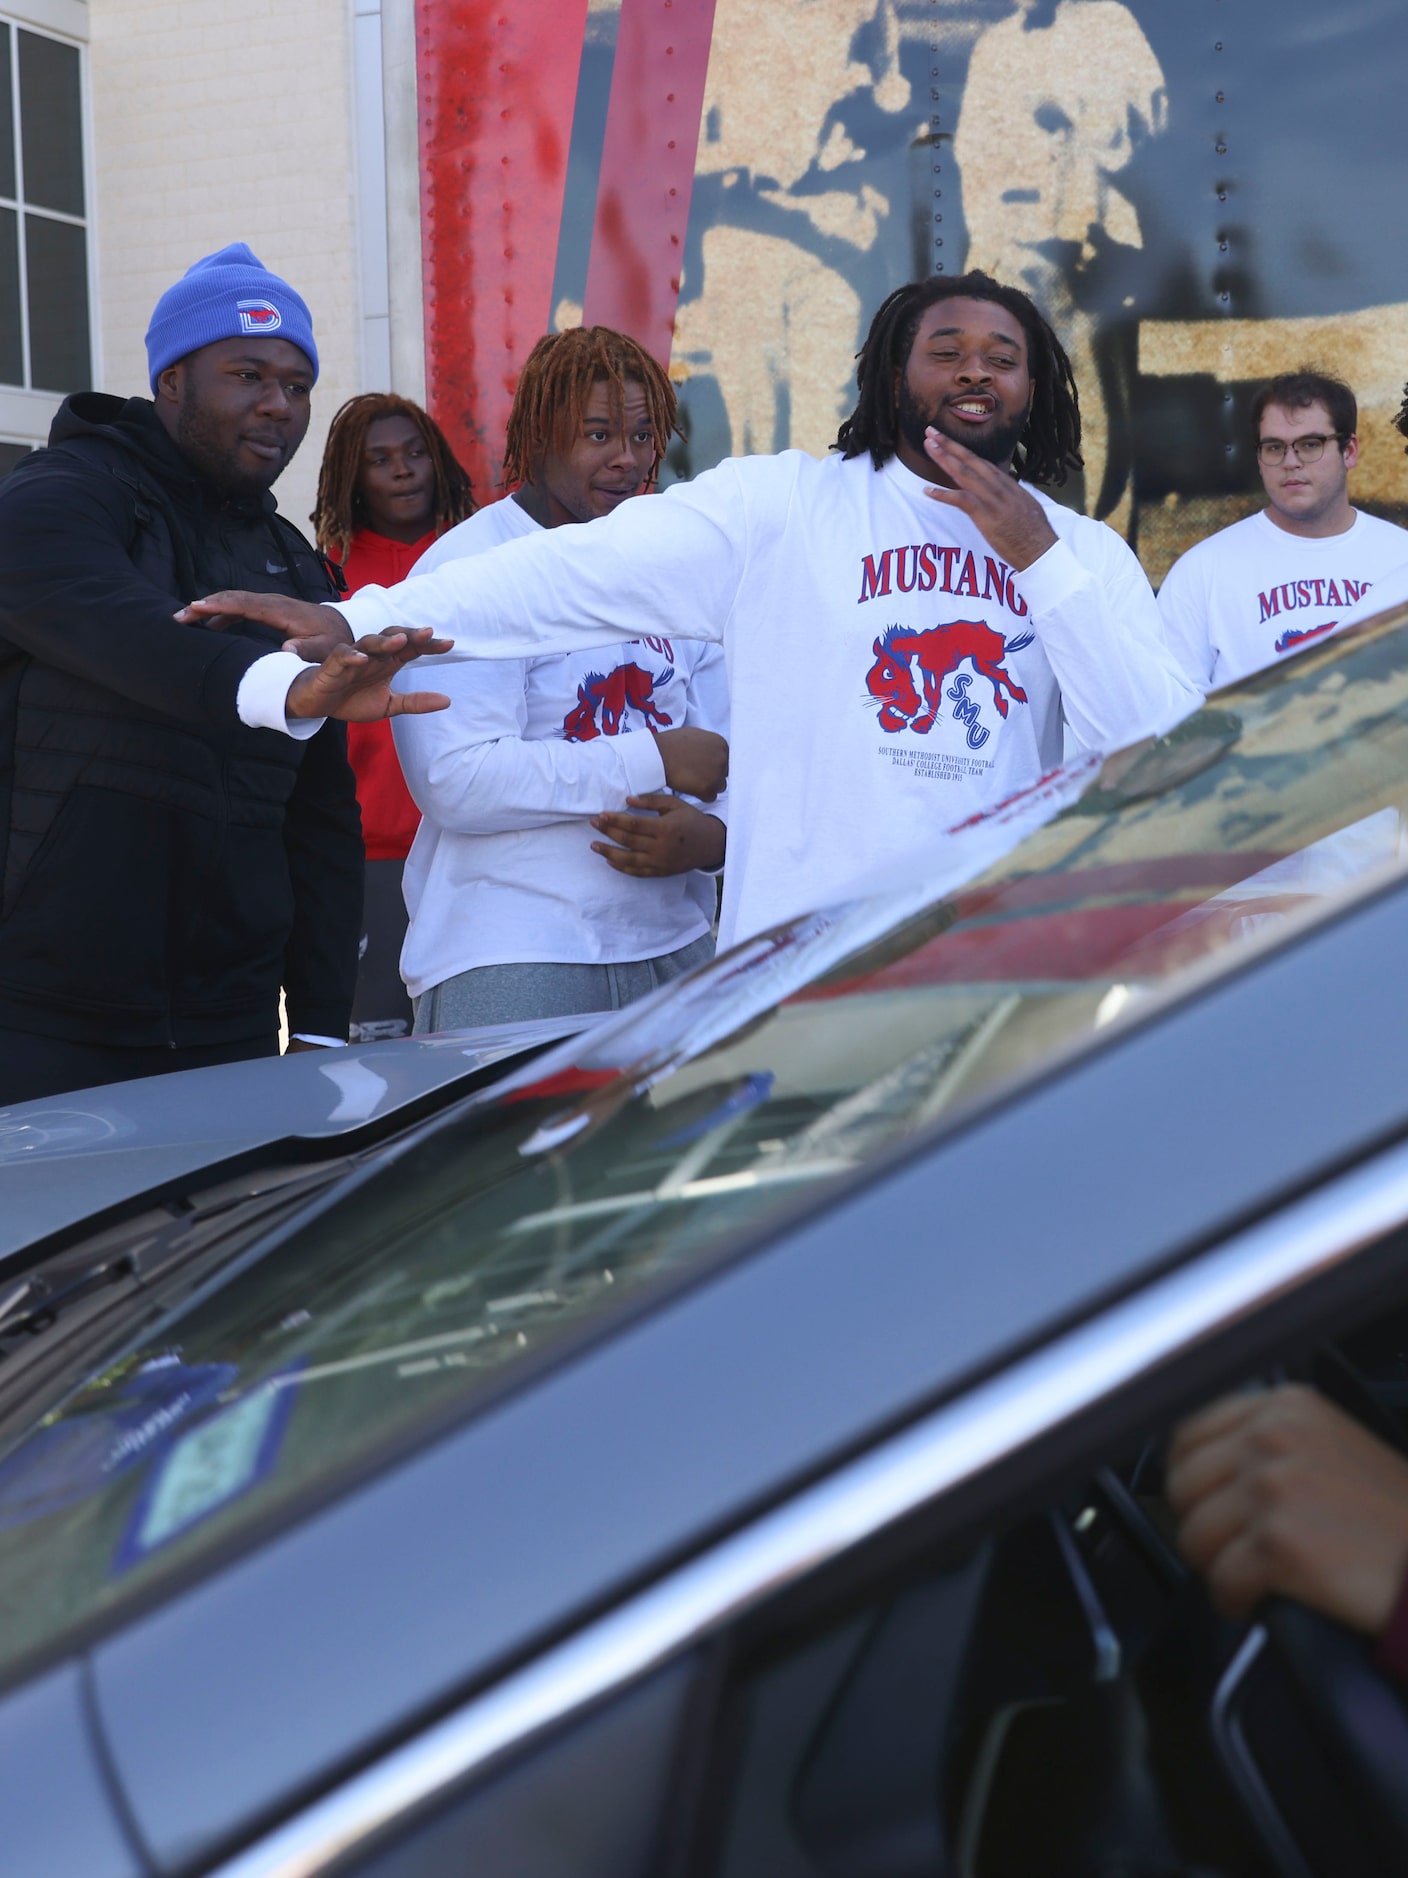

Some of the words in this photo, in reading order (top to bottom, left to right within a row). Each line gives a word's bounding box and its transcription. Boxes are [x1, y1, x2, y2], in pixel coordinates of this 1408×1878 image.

[857, 542, 1034, 626] MUSTANG
[946, 673, 990, 750] SMU
[878, 746, 907, 757] SOUTHERN
[909, 750, 940, 762] METHODIST
[971, 759, 995, 768] FOOTBAL
[914, 768, 951, 780] ESTABLISHED
[952, 773, 963, 782] 1915
[916, 760, 941, 771] COLLEGE
[968, 767, 984, 777] TEAM
